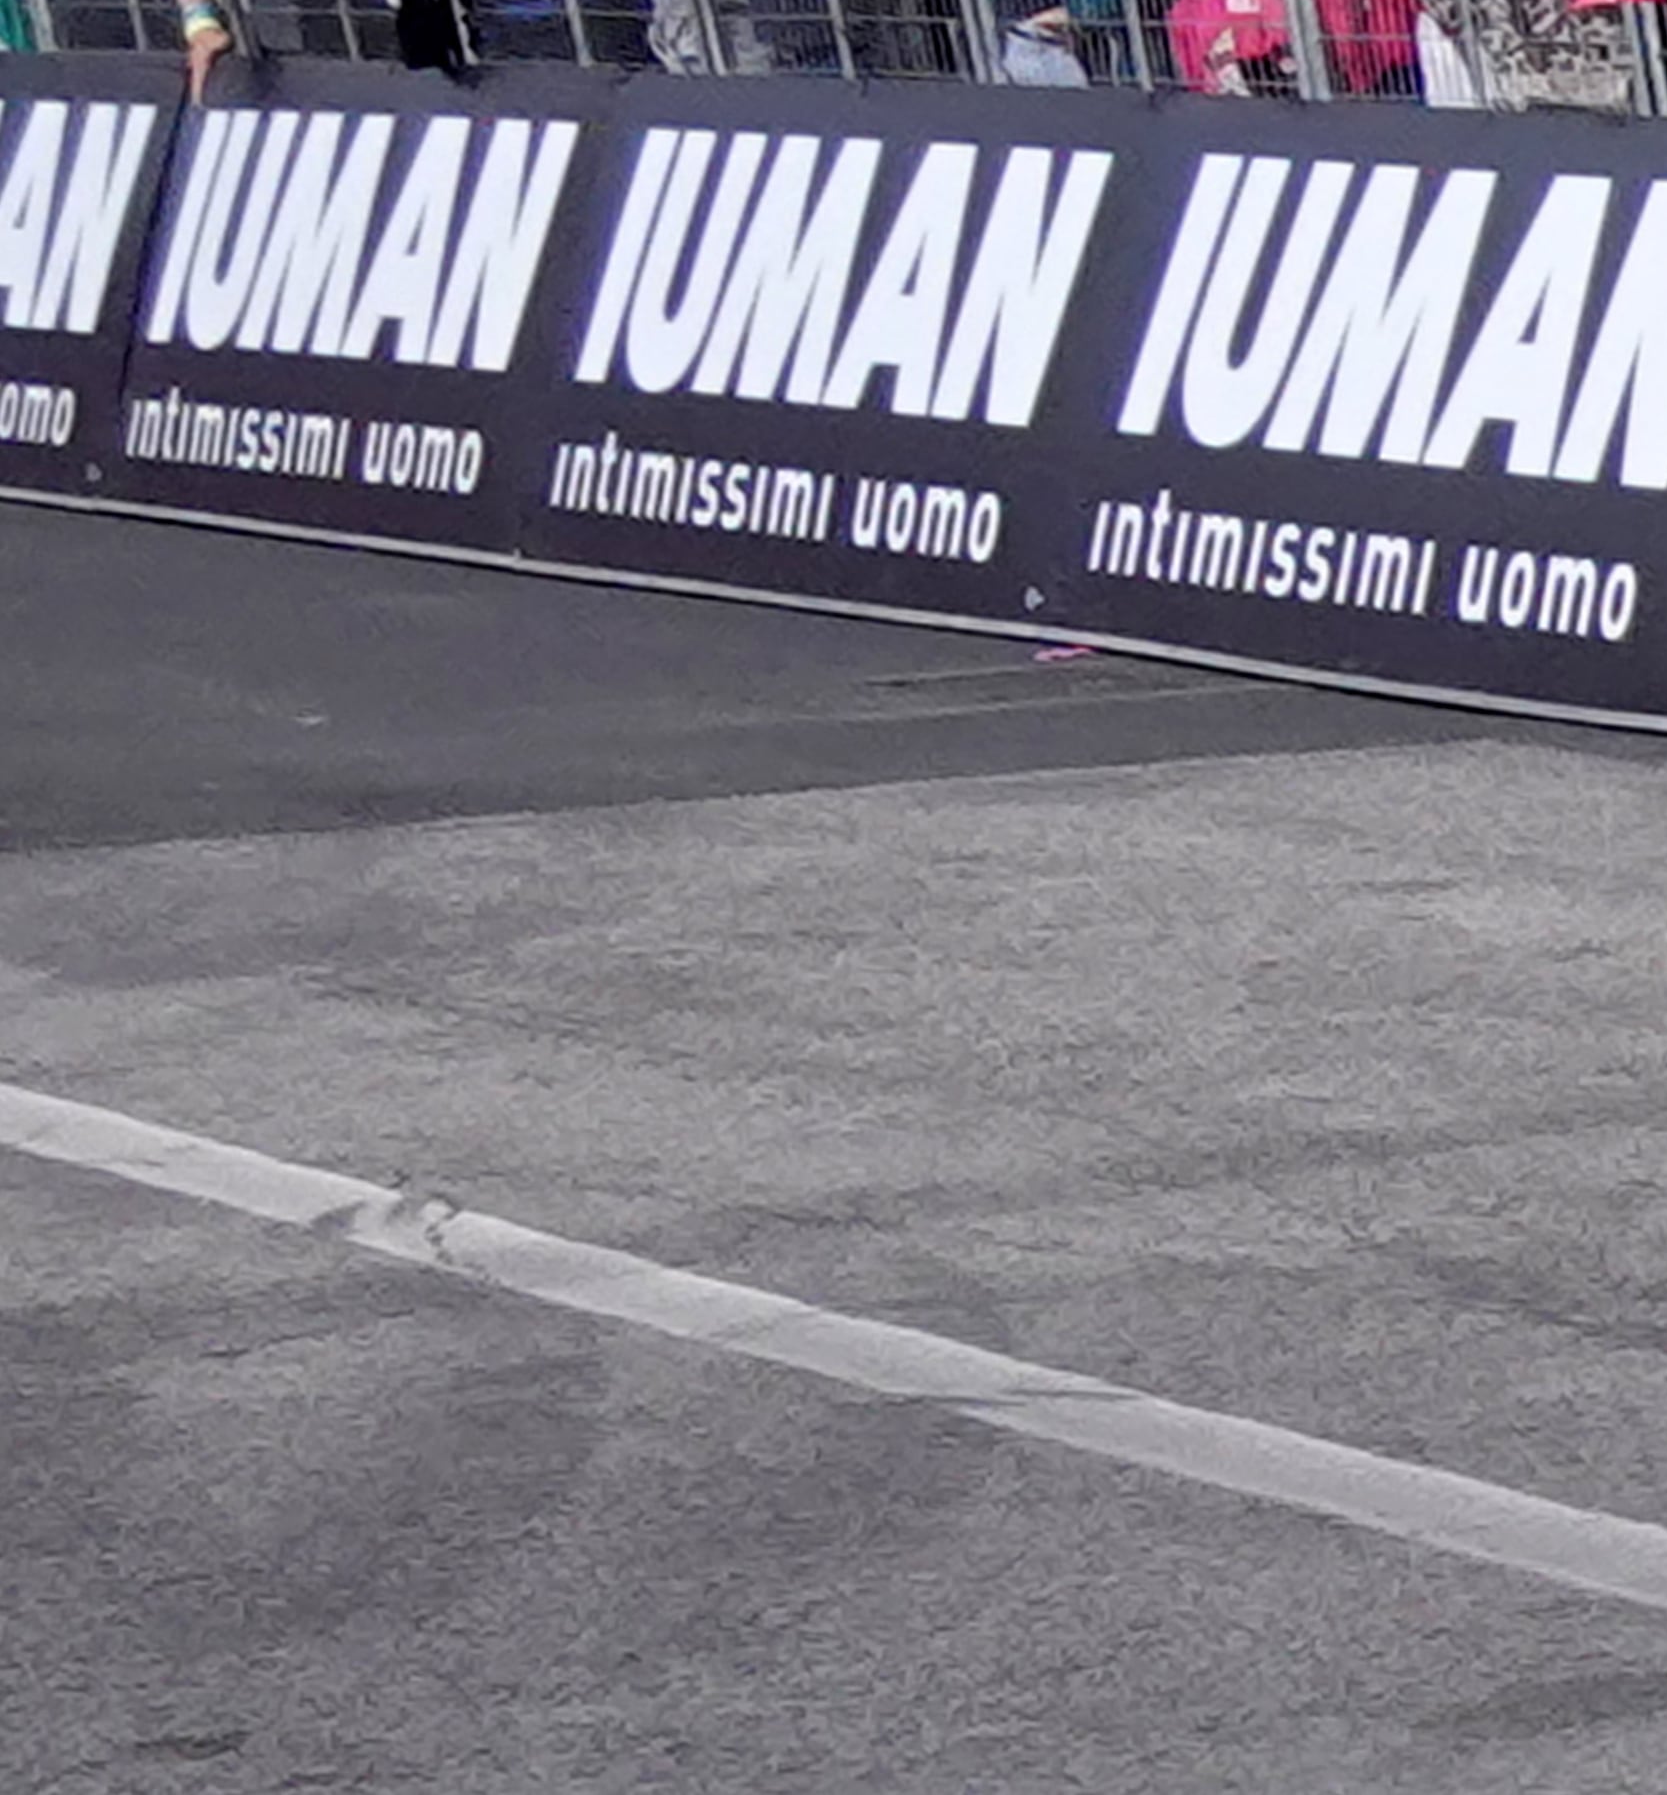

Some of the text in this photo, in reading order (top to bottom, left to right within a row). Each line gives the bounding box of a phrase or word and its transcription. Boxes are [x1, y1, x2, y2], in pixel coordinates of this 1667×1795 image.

[0, 98, 158, 334] AN
[146, 108, 580, 372] IUMAN
[574, 126, 1114, 428] IUMAN
[125, 387, 483, 494] intimissimi uomo
[550, 431, 1001, 563] intimissimi uomo
[1088, 489, 1638, 642] intimissimi uomo
